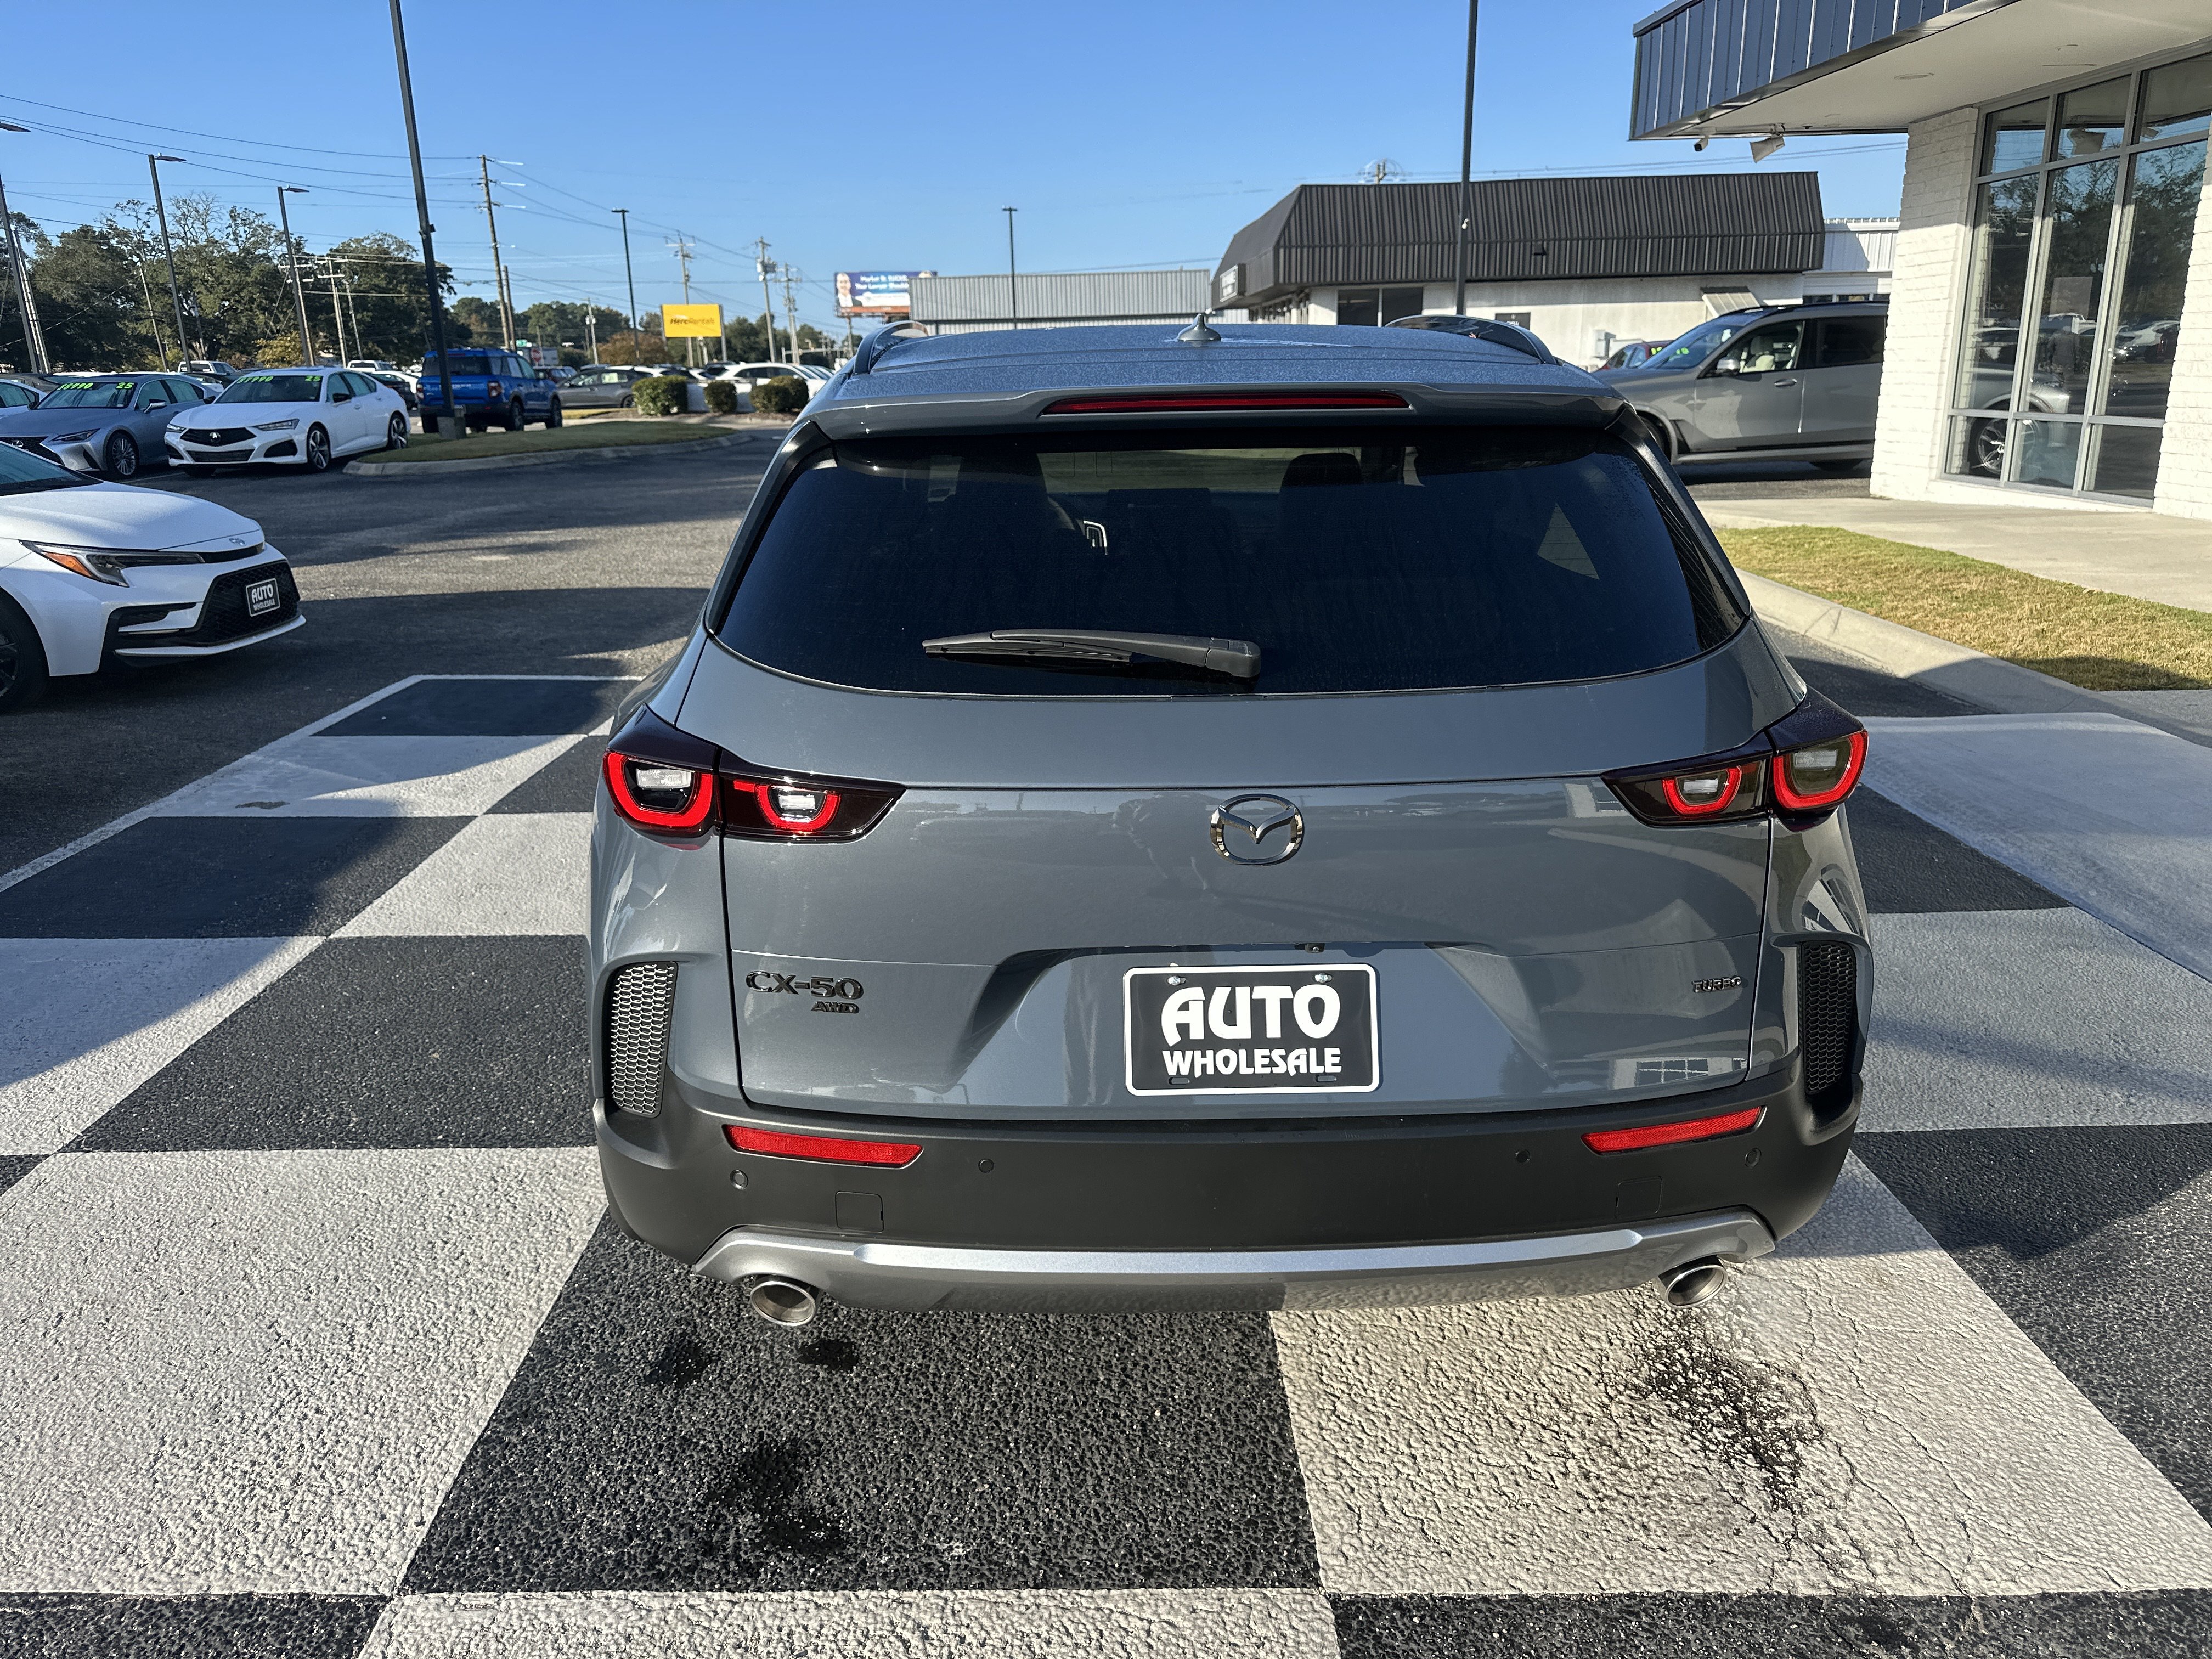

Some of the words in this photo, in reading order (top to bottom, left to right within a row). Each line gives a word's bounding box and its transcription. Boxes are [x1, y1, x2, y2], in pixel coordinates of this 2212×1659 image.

[251, 584, 274, 603] AUTO
[746, 969, 865, 1000] CX-50
[1691, 975, 1742, 994] TURBO
[810, 1000, 860, 1014] AWD
[1160, 984, 1341, 1047] AUTO
[1161, 1047, 1342, 1078] WHOLESALE
